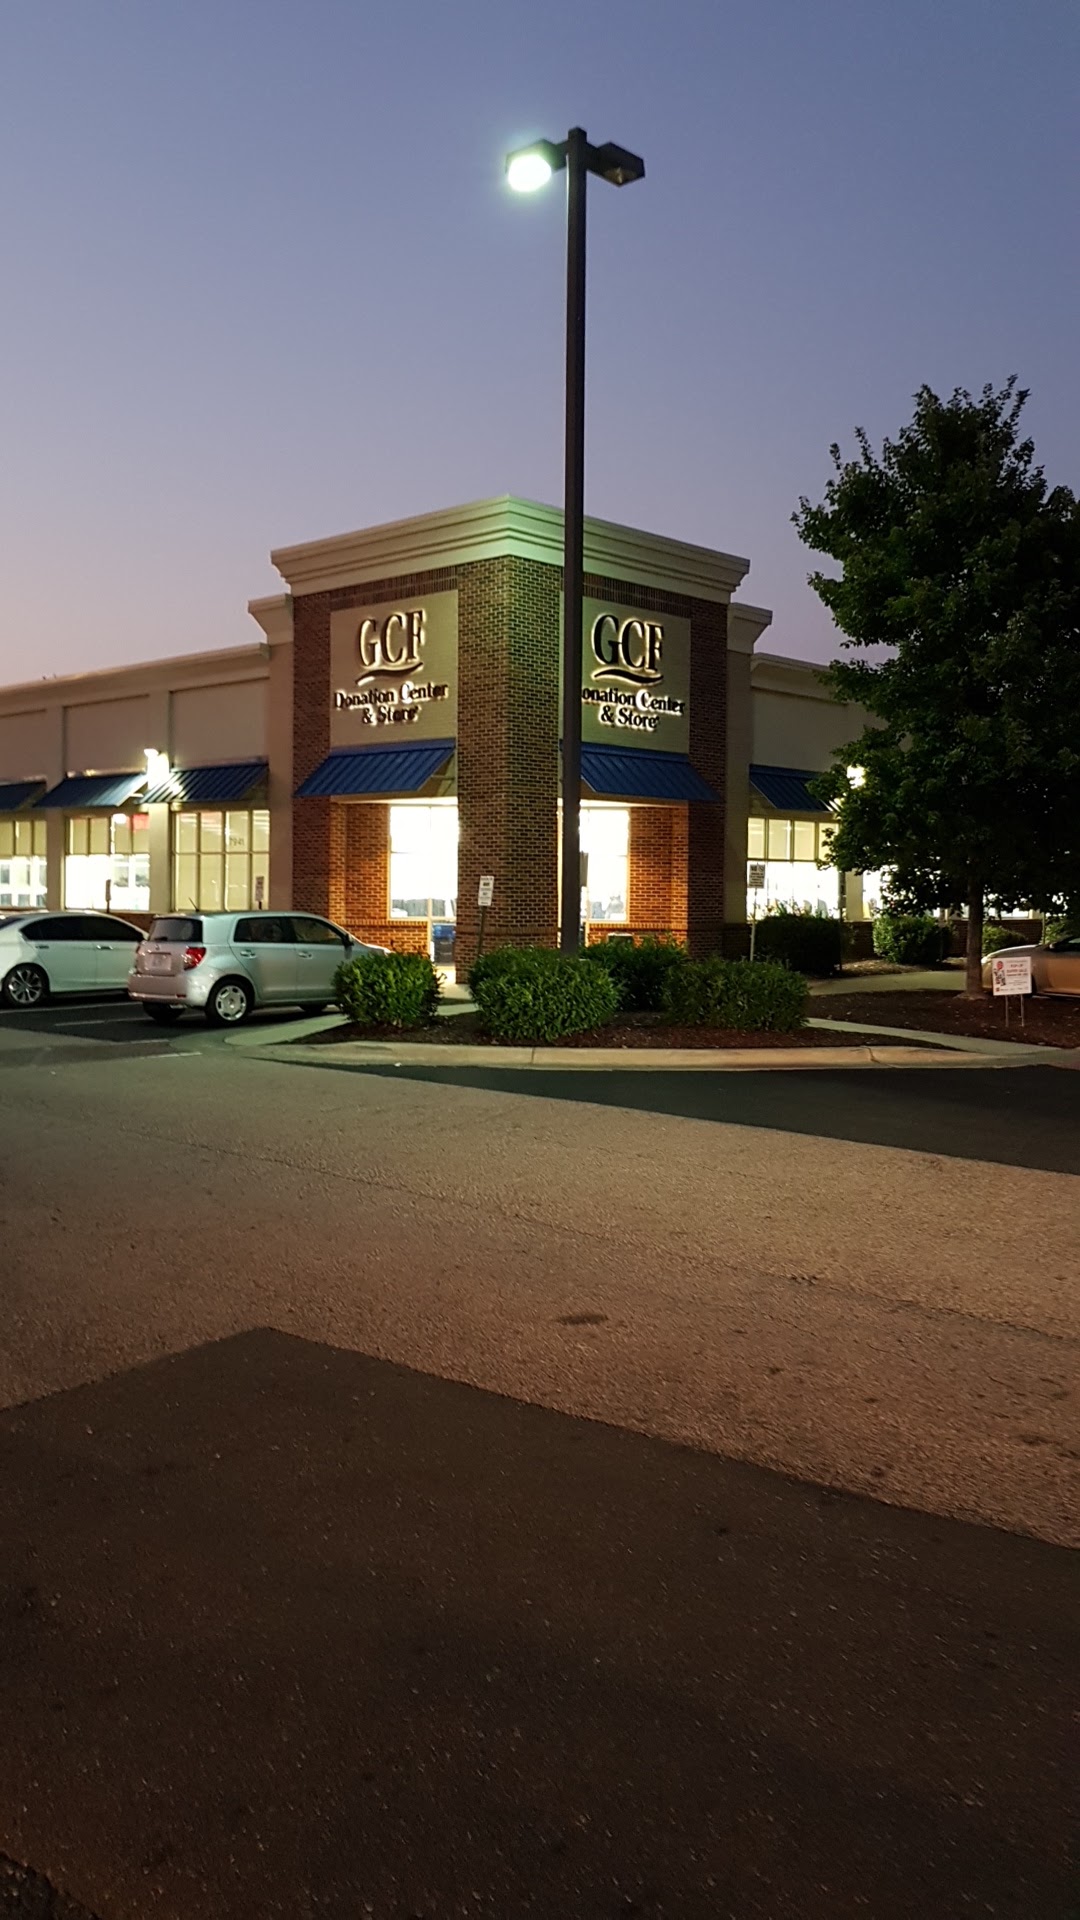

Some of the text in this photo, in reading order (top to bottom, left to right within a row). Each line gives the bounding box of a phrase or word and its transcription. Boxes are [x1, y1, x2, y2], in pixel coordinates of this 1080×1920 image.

[358, 609, 425, 667] GCF
[592, 613, 665, 673] GCF
[334, 681, 449, 709] Donation Center
[581, 687, 686, 715] onation Center
[362, 705, 420, 724] & Store
[600, 705, 660, 729] & Store
